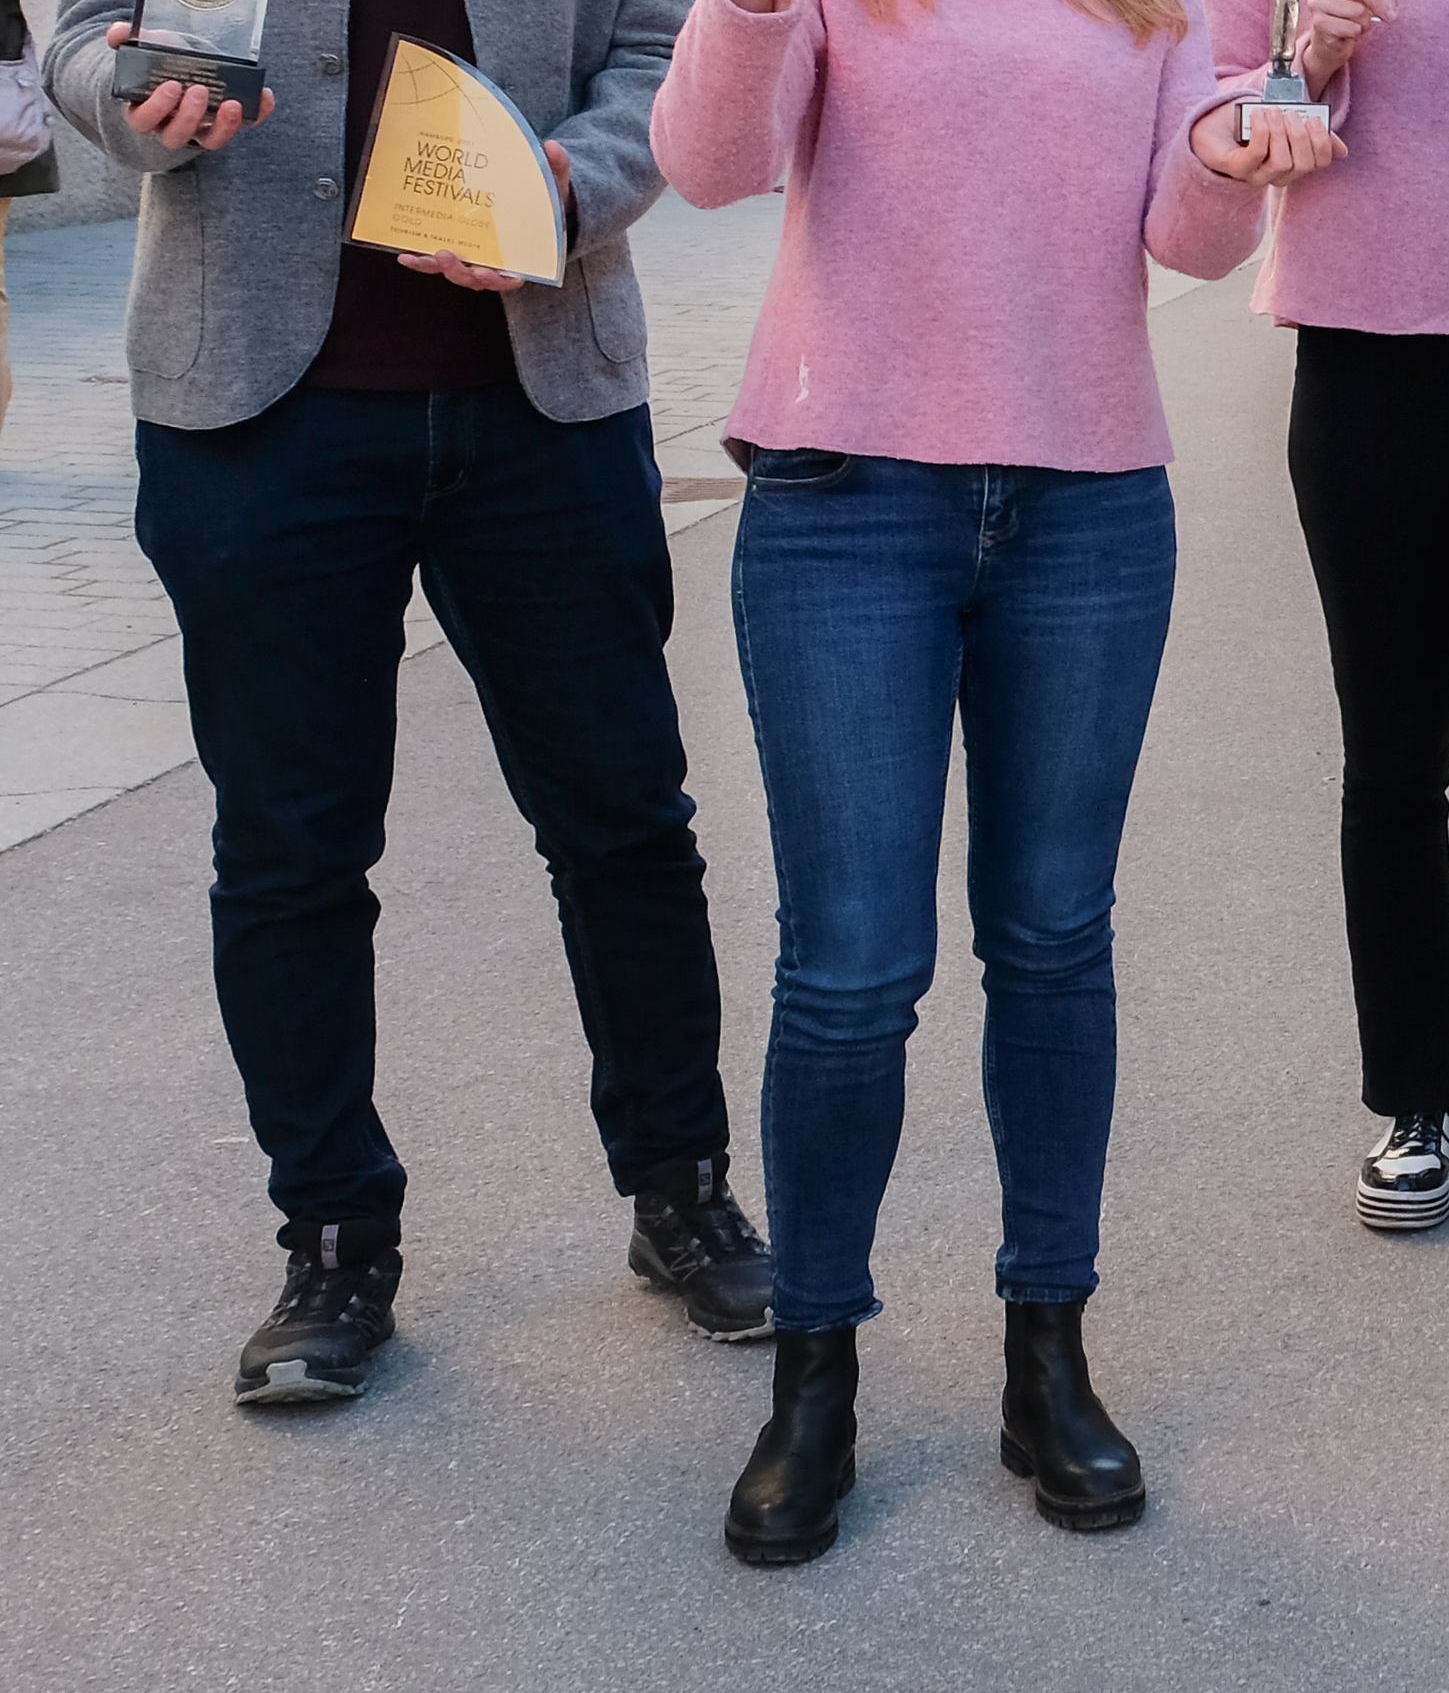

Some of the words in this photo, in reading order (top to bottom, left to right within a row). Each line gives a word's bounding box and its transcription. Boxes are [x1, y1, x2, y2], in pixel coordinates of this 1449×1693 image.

[418, 141, 489, 169] WORLD
[404, 157, 466, 184] MEDIA
[403, 175, 495, 208] FESTIVALS
[392, 214, 422, 226] GOLD
[395, 203, 491, 229] INTERMEDIA-GLOBE
